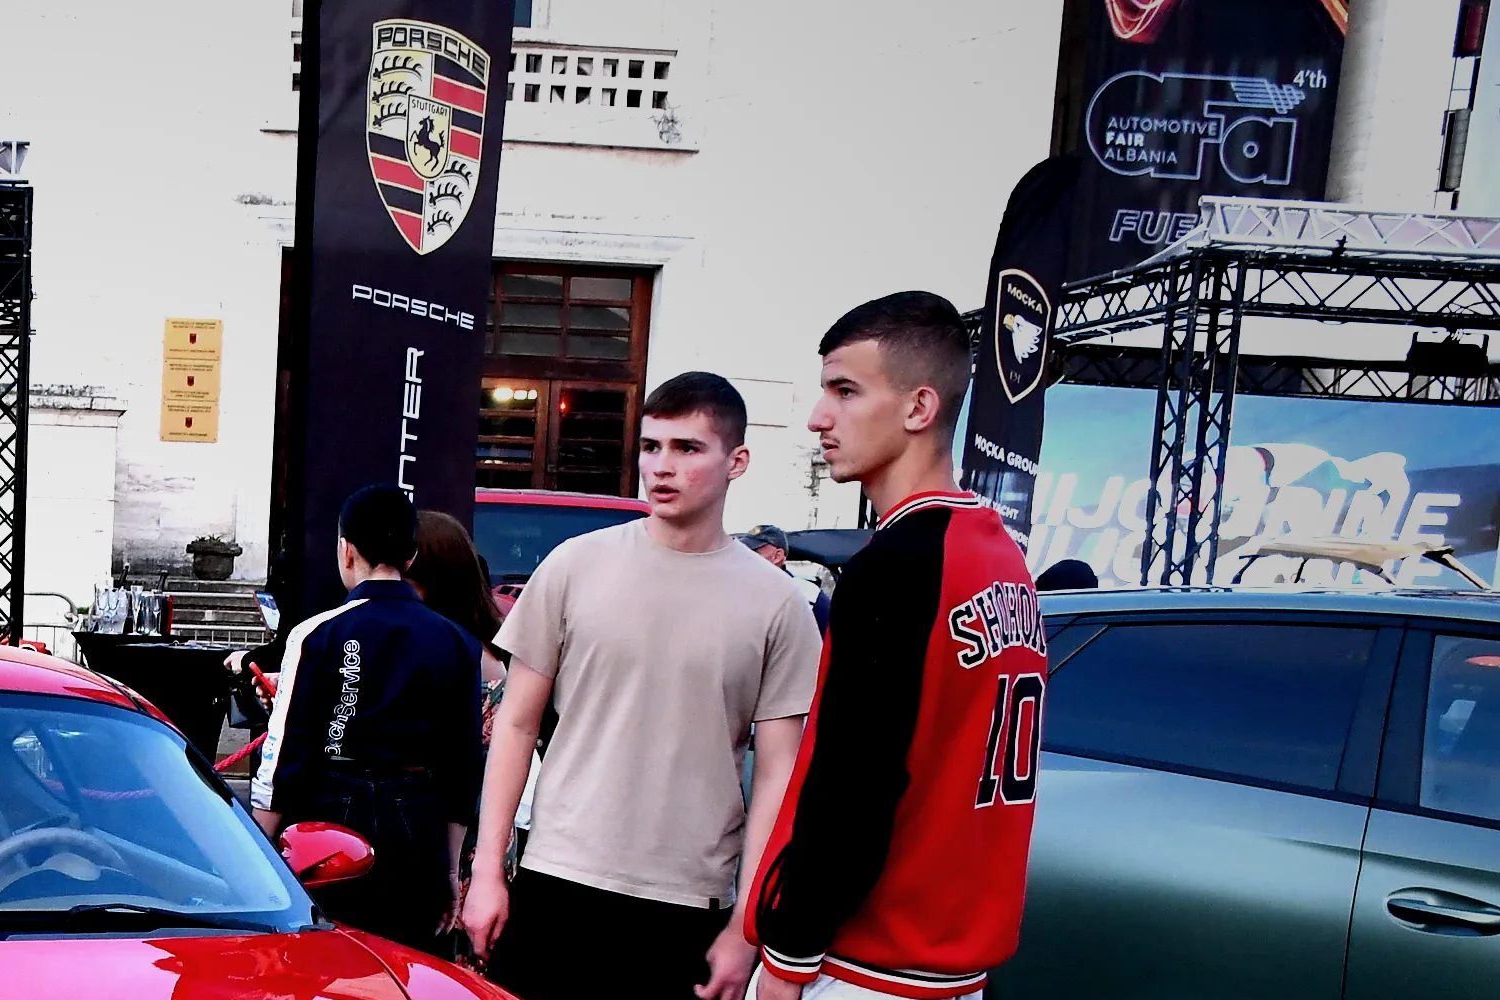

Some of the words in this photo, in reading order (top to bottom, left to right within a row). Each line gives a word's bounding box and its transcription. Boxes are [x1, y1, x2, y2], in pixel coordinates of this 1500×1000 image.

[377, 27, 486, 80] PORSCHE
[411, 98, 449, 117] STUTTGART
[1105, 131, 1145, 147] FAIR
[1107, 116, 1218, 136] AUTOMOTIVE
[1103, 148, 1178, 165] ALBANIA
[352, 284, 475, 331] PORSCHE
[398, 346, 425, 504] NTER
[974, 672, 1046, 810] 10
